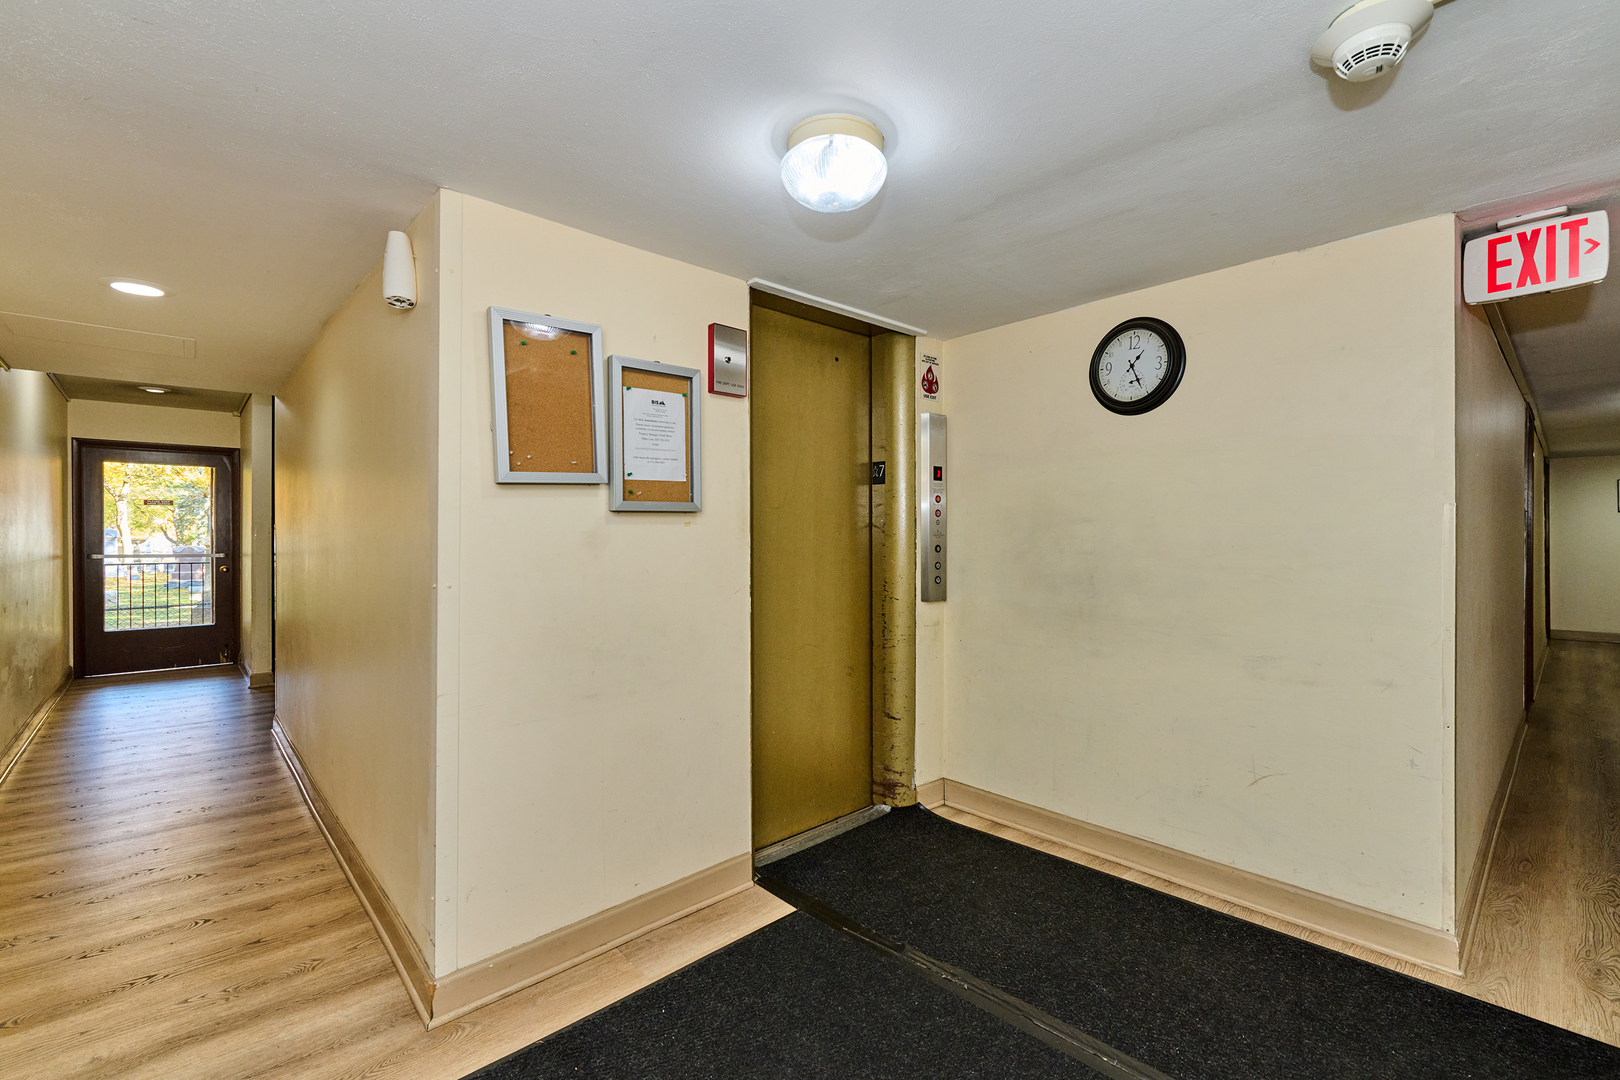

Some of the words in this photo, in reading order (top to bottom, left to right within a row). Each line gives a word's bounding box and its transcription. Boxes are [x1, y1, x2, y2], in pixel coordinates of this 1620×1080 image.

[1487, 217, 1589, 294] EXIT
[1128, 334, 1141, 350] 12
[1105, 362, 1112, 376] 9
[1154, 356, 1162, 370] 3
